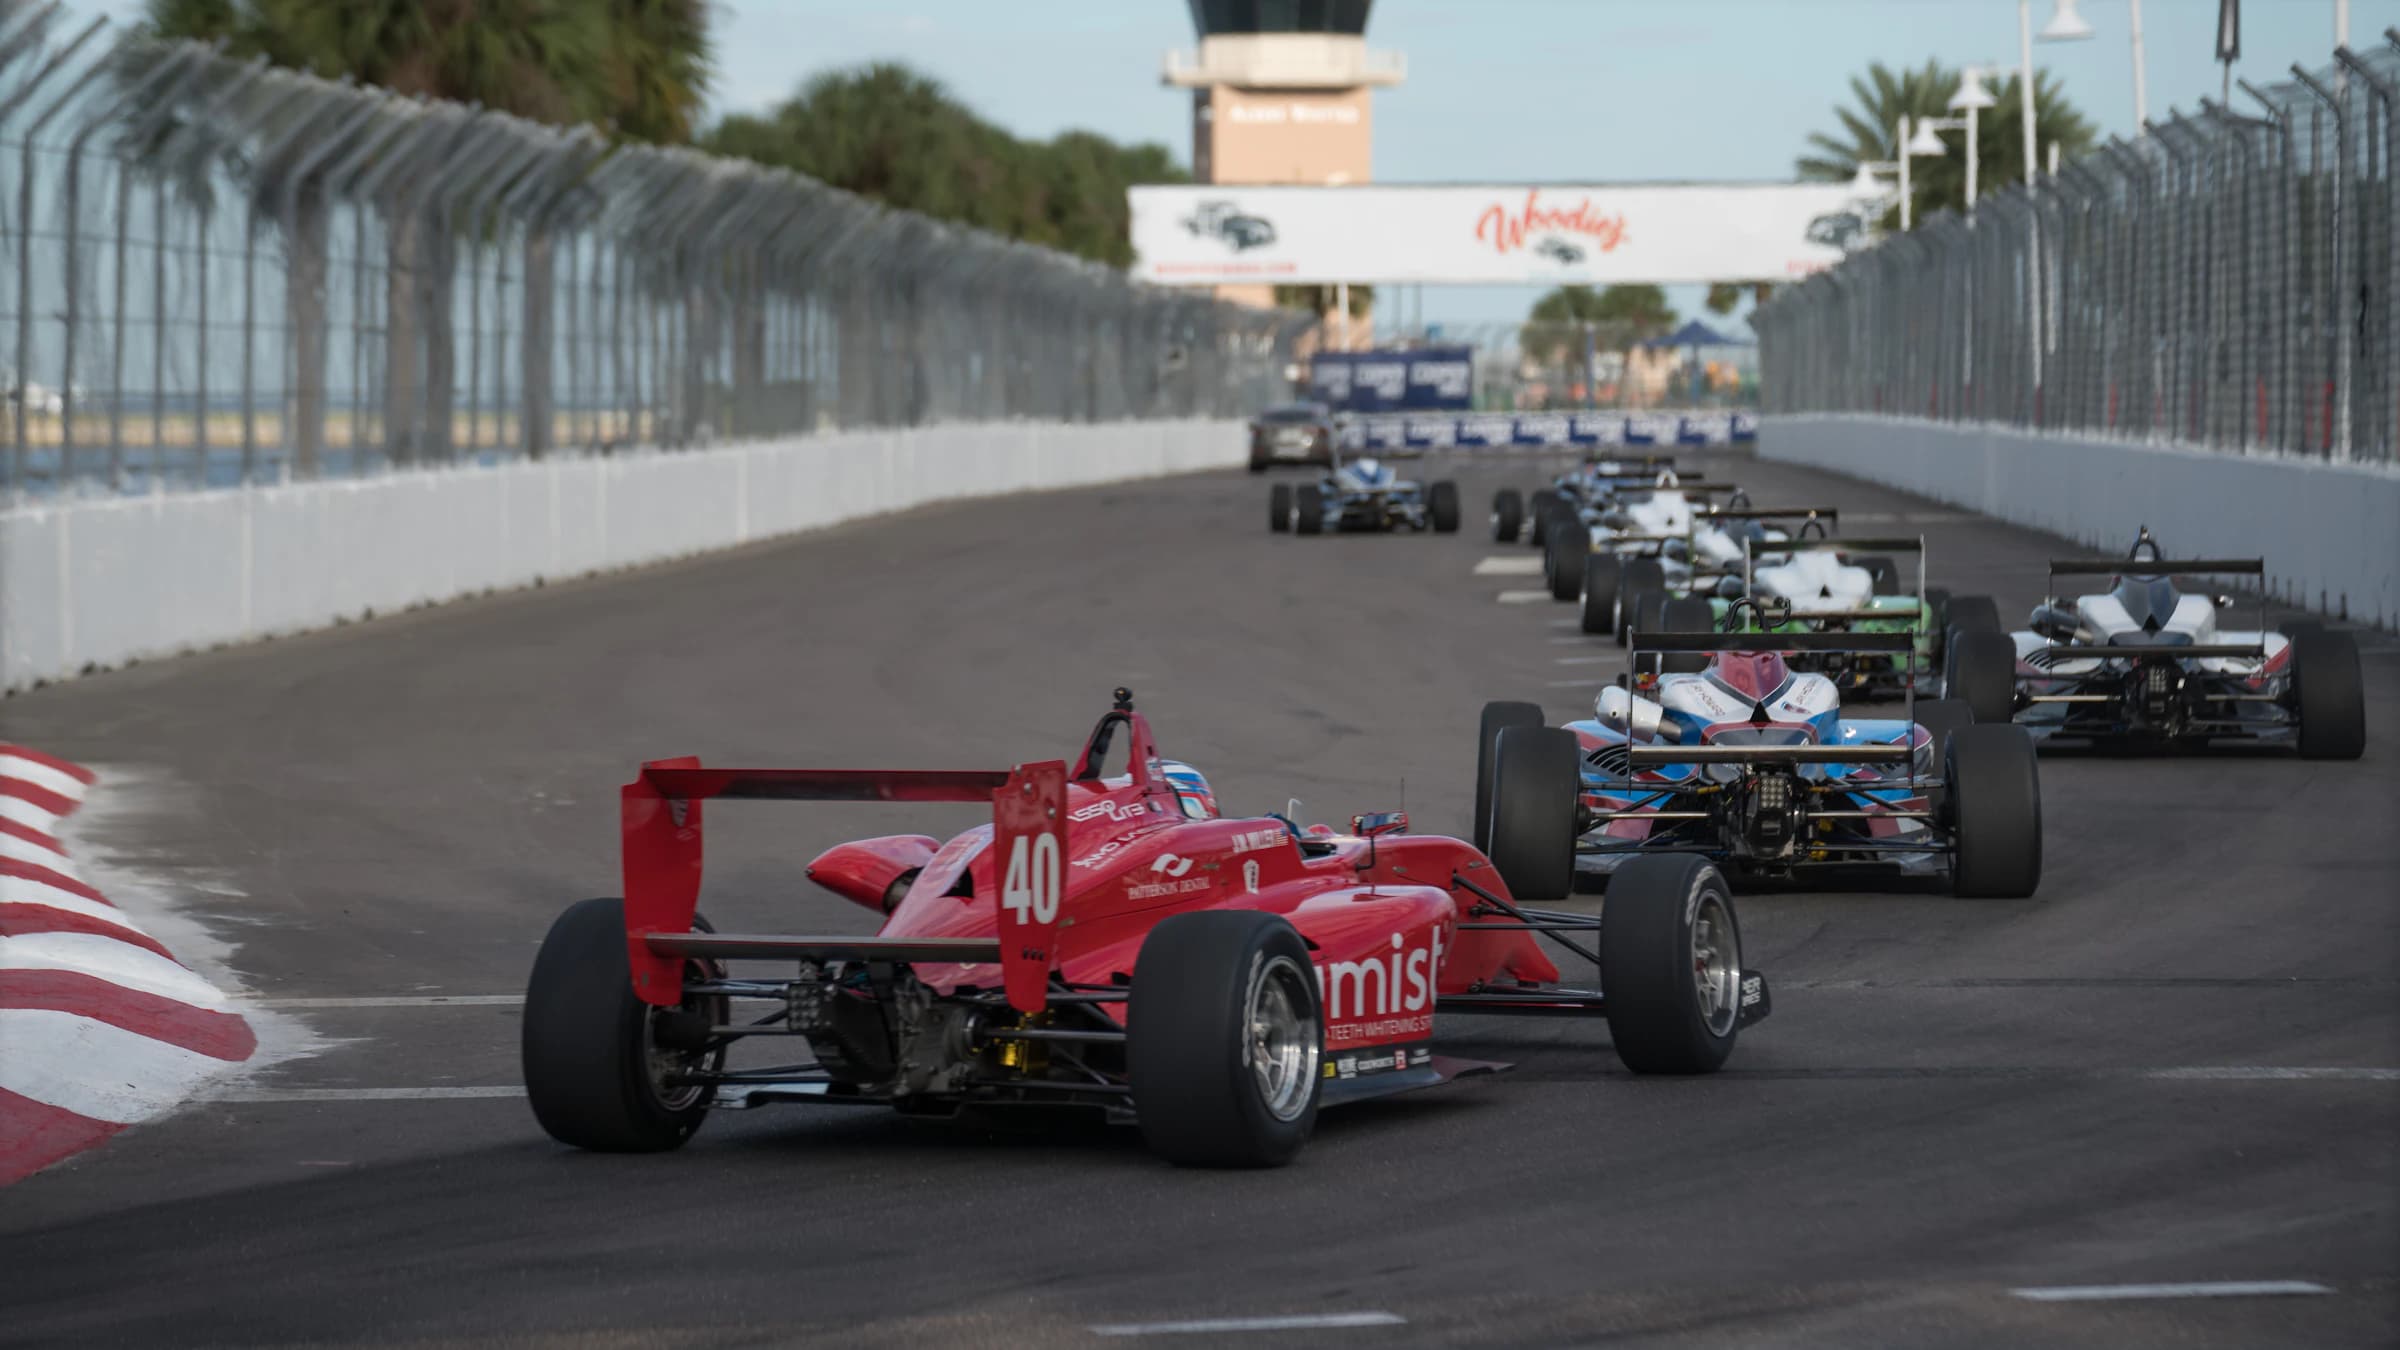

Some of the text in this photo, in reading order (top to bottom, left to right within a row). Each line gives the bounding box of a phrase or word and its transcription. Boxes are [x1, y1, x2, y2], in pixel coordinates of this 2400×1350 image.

[1003, 832, 1060, 926] 40
[1313, 925, 1443, 1019] mist
[1329, 1022, 1365, 1041] TEETH
[1365, 1016, 1419, 1037] WHITENING
